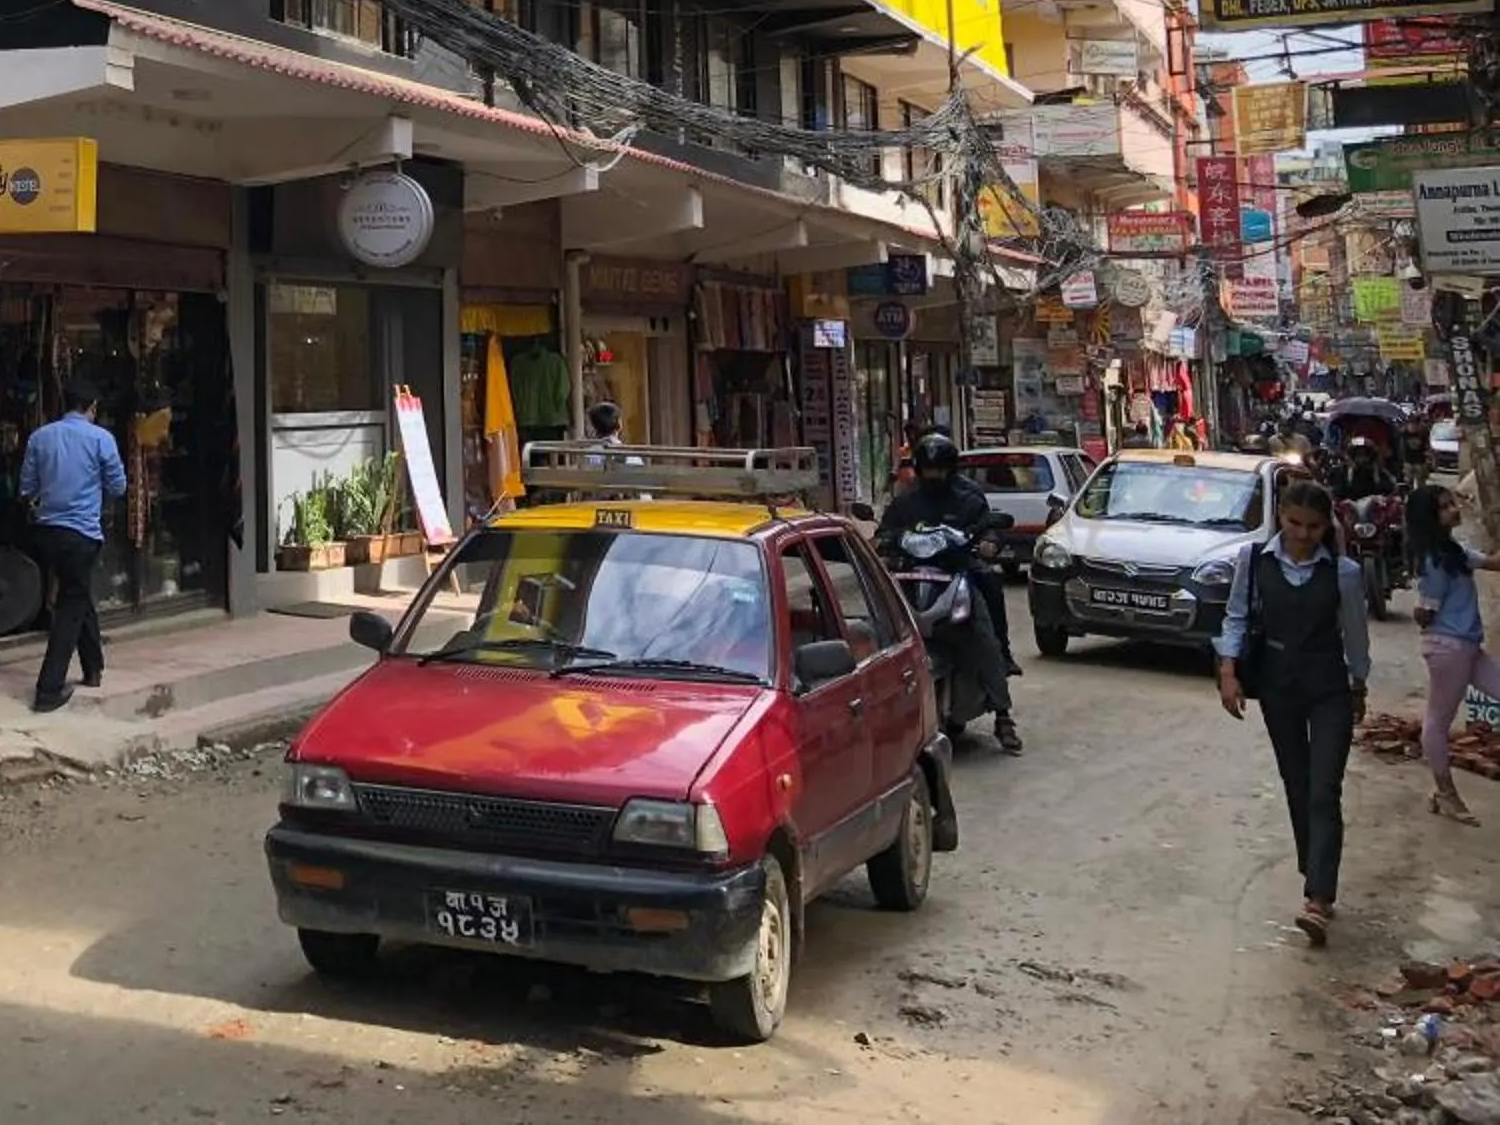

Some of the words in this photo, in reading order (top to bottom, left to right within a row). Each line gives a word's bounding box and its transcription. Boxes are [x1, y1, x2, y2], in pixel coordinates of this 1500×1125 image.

[1419, 182, 1489, 204] Annapurna
[1451, 336, 1483, 418] SHONAS
[598, 510, 628, 526] TAXI
